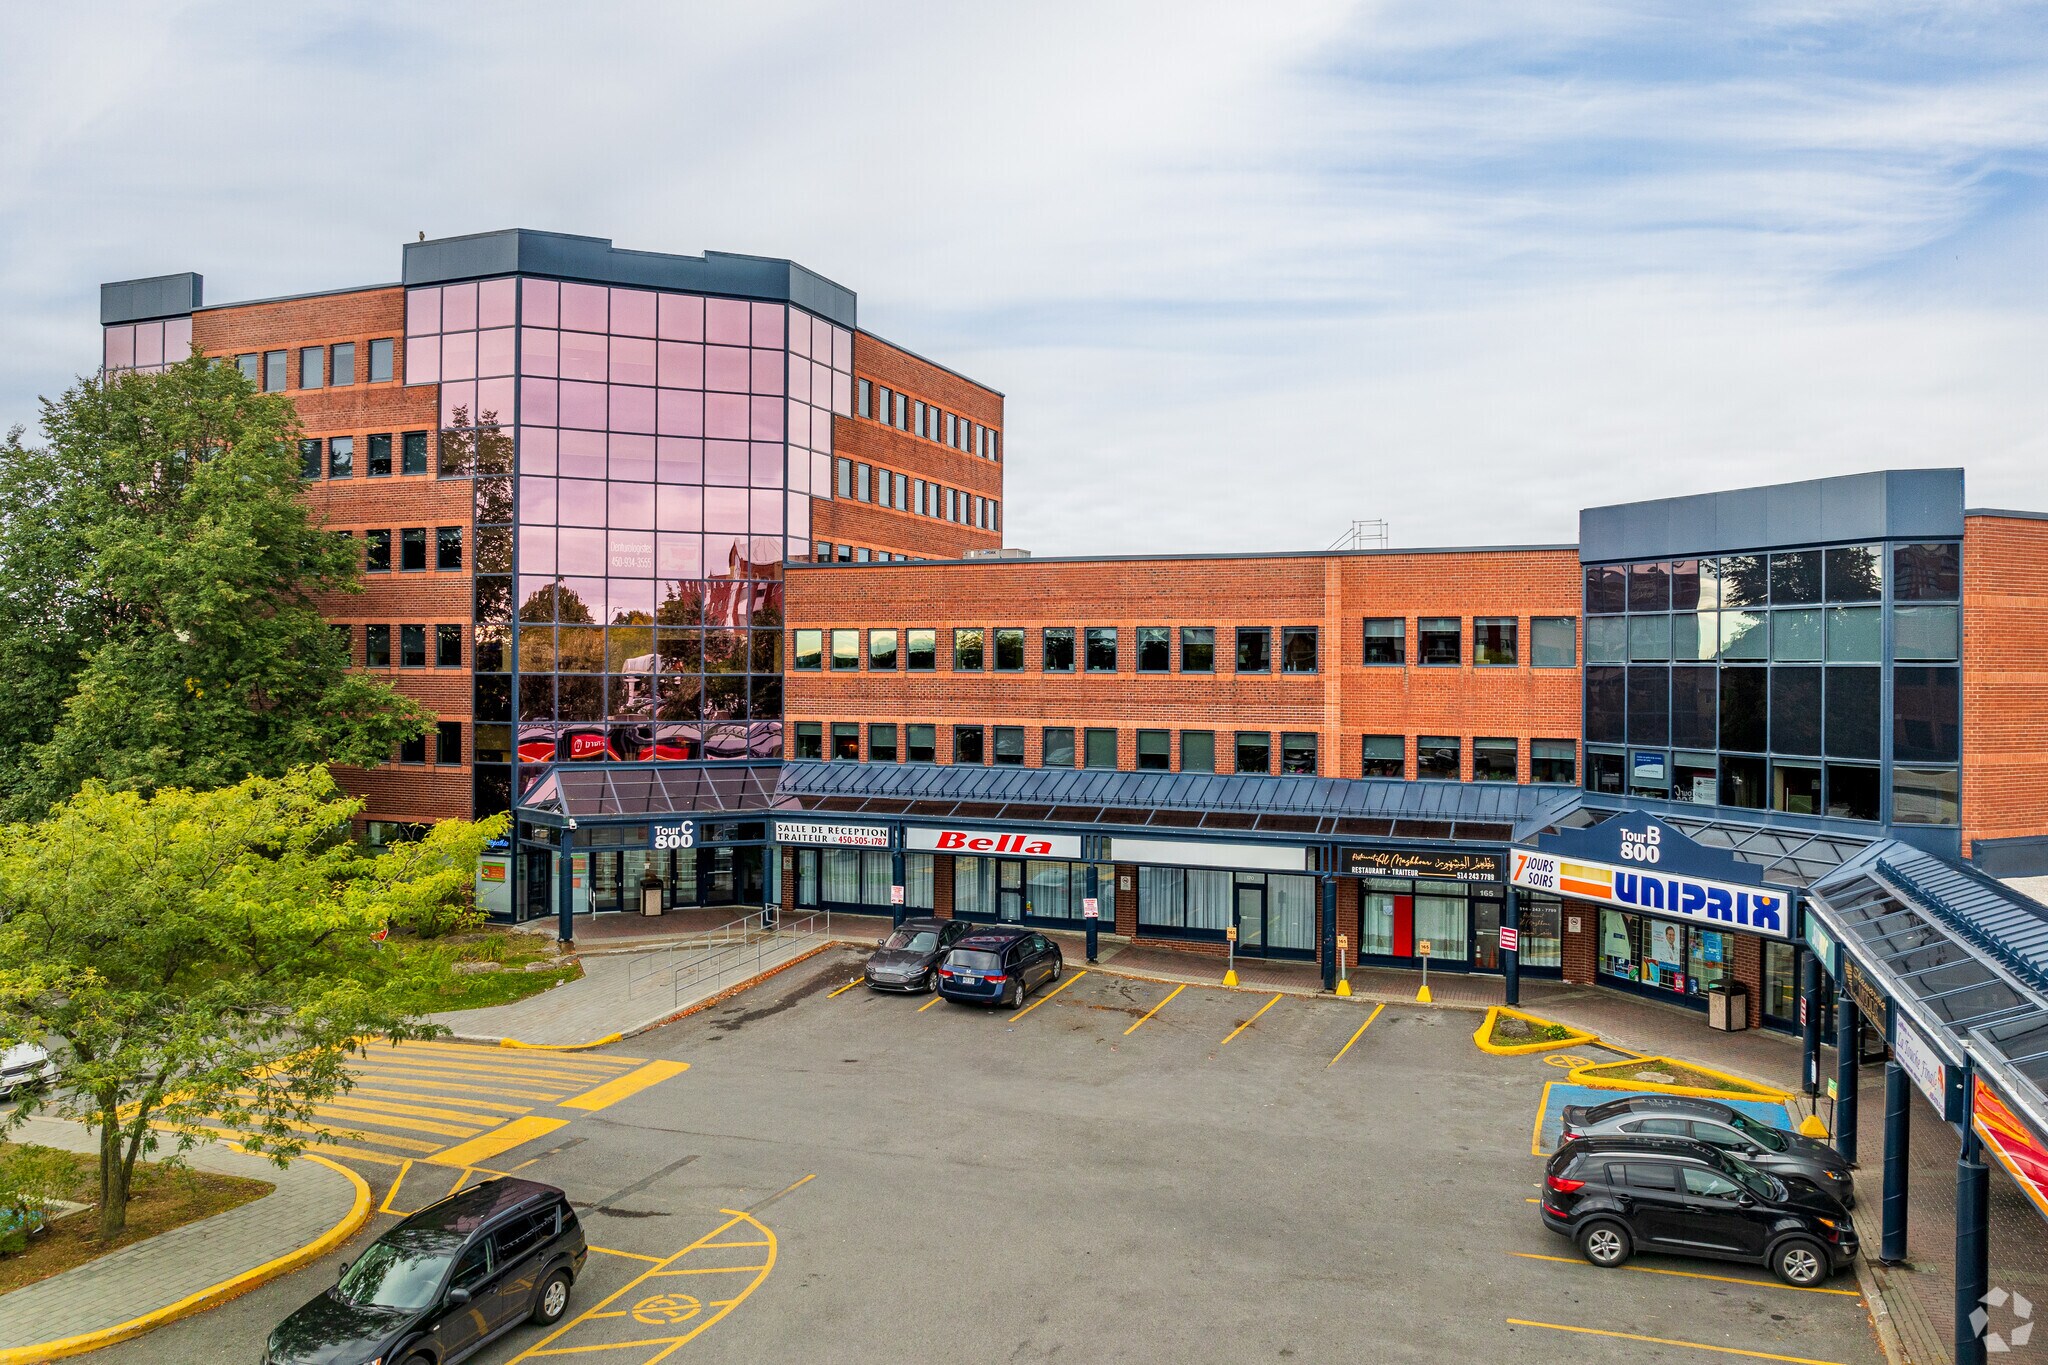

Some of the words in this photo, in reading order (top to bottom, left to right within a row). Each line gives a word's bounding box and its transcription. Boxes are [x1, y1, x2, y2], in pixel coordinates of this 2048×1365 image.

[610, 541, 652, 555] Denturologistes
[654, 826, 680, 835] Tour
[681, 820, 694, 835] C
[778, 825, 806, 833] SALLE
[811, 826, 823, 834] DE
[828, 826, 887, 837] RÉCEPTION
[1620, 828, 1647, 843] Tour
[1647, 825, 1661, 845] B
[654, 835, 694, 849] 800
[778, 833, 828, 842] TRAITEUR
[838, 836, 887, 846] 450-505-1787
[935, 831, 1053, 854] Bella
[1620, 842, 1660, 863] 800
[1351, 866, 1386, 875] RESTAURANT
[1392, 868, 1419, 877] TRAITEUR
[1456, 871, 1468, 880] 514
[1468, 872, 1480, 880] 243
[1513, 854, 1528, 881] 7
[1526, 857, 1554, 873] JOURS
[1528, 872, 1554, 888] SOIRS
[1615, 871, 1780, 931] UNIPRIX
